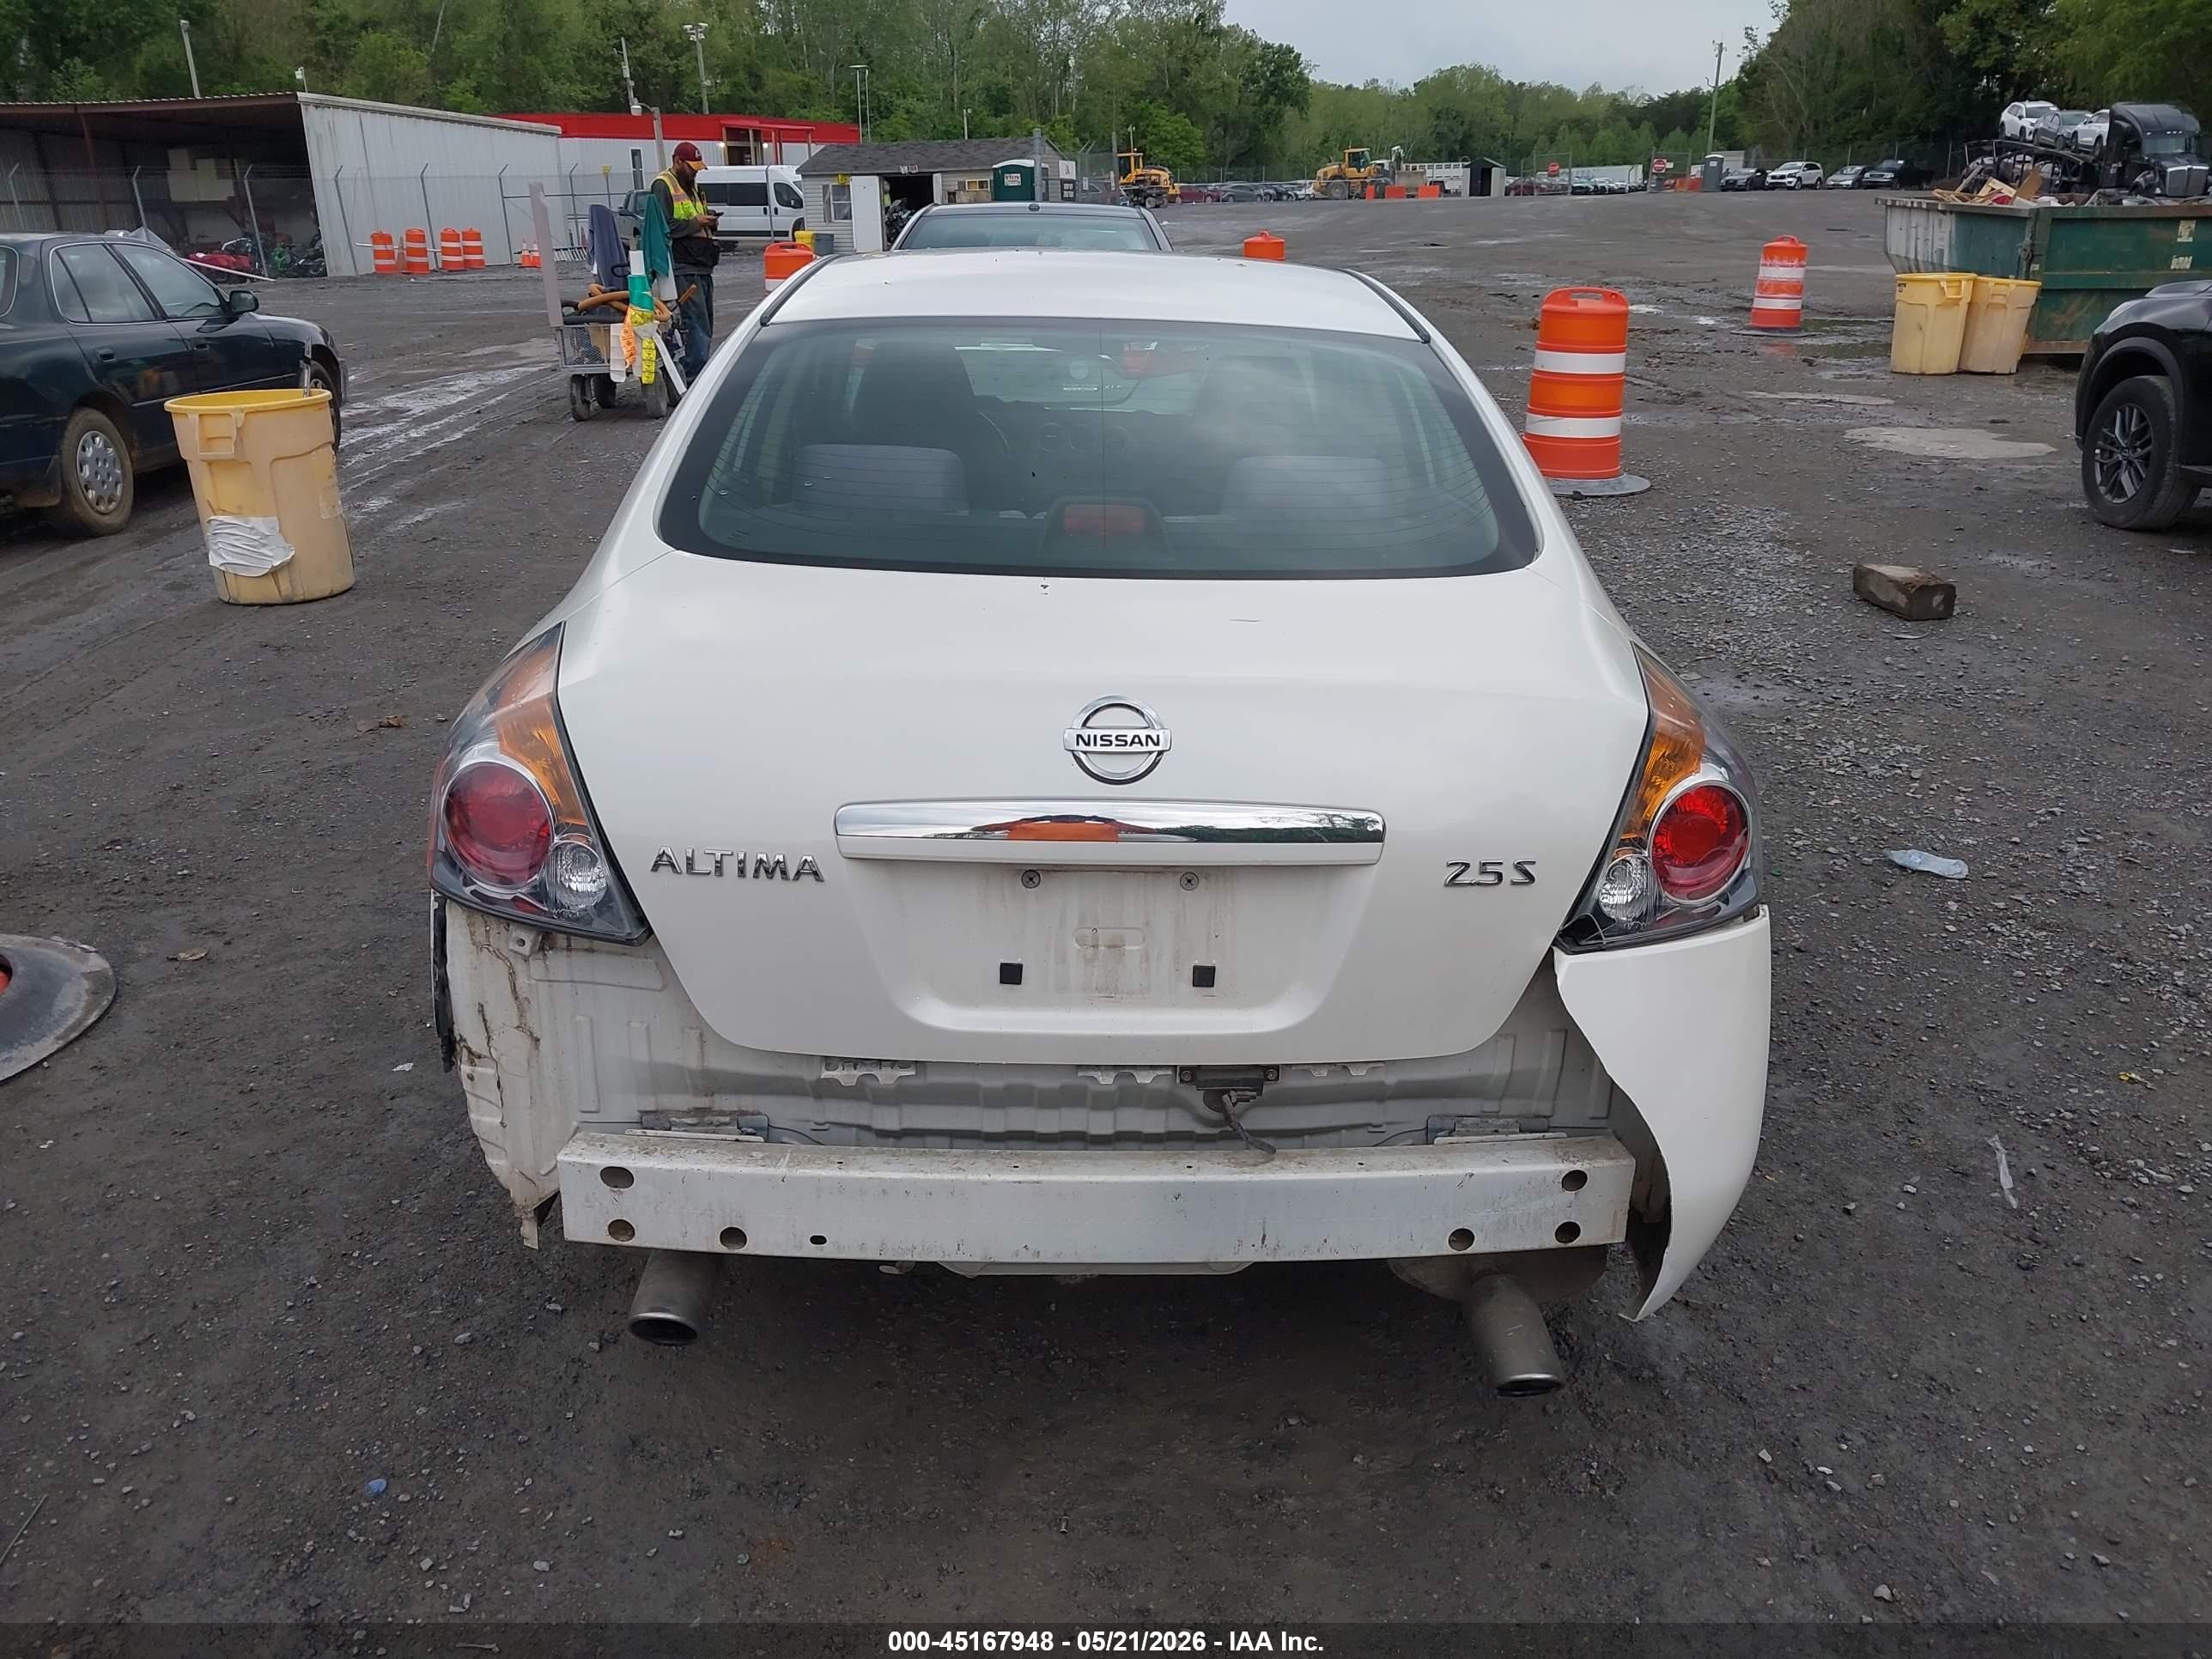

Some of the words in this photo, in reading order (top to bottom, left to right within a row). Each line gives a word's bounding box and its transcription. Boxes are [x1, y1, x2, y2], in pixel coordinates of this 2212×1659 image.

[1075, 733, 1160, 747] NISSAN
[650, 845, 825, 883] ALTIMA
[1510, 858, 1537, 886] S
